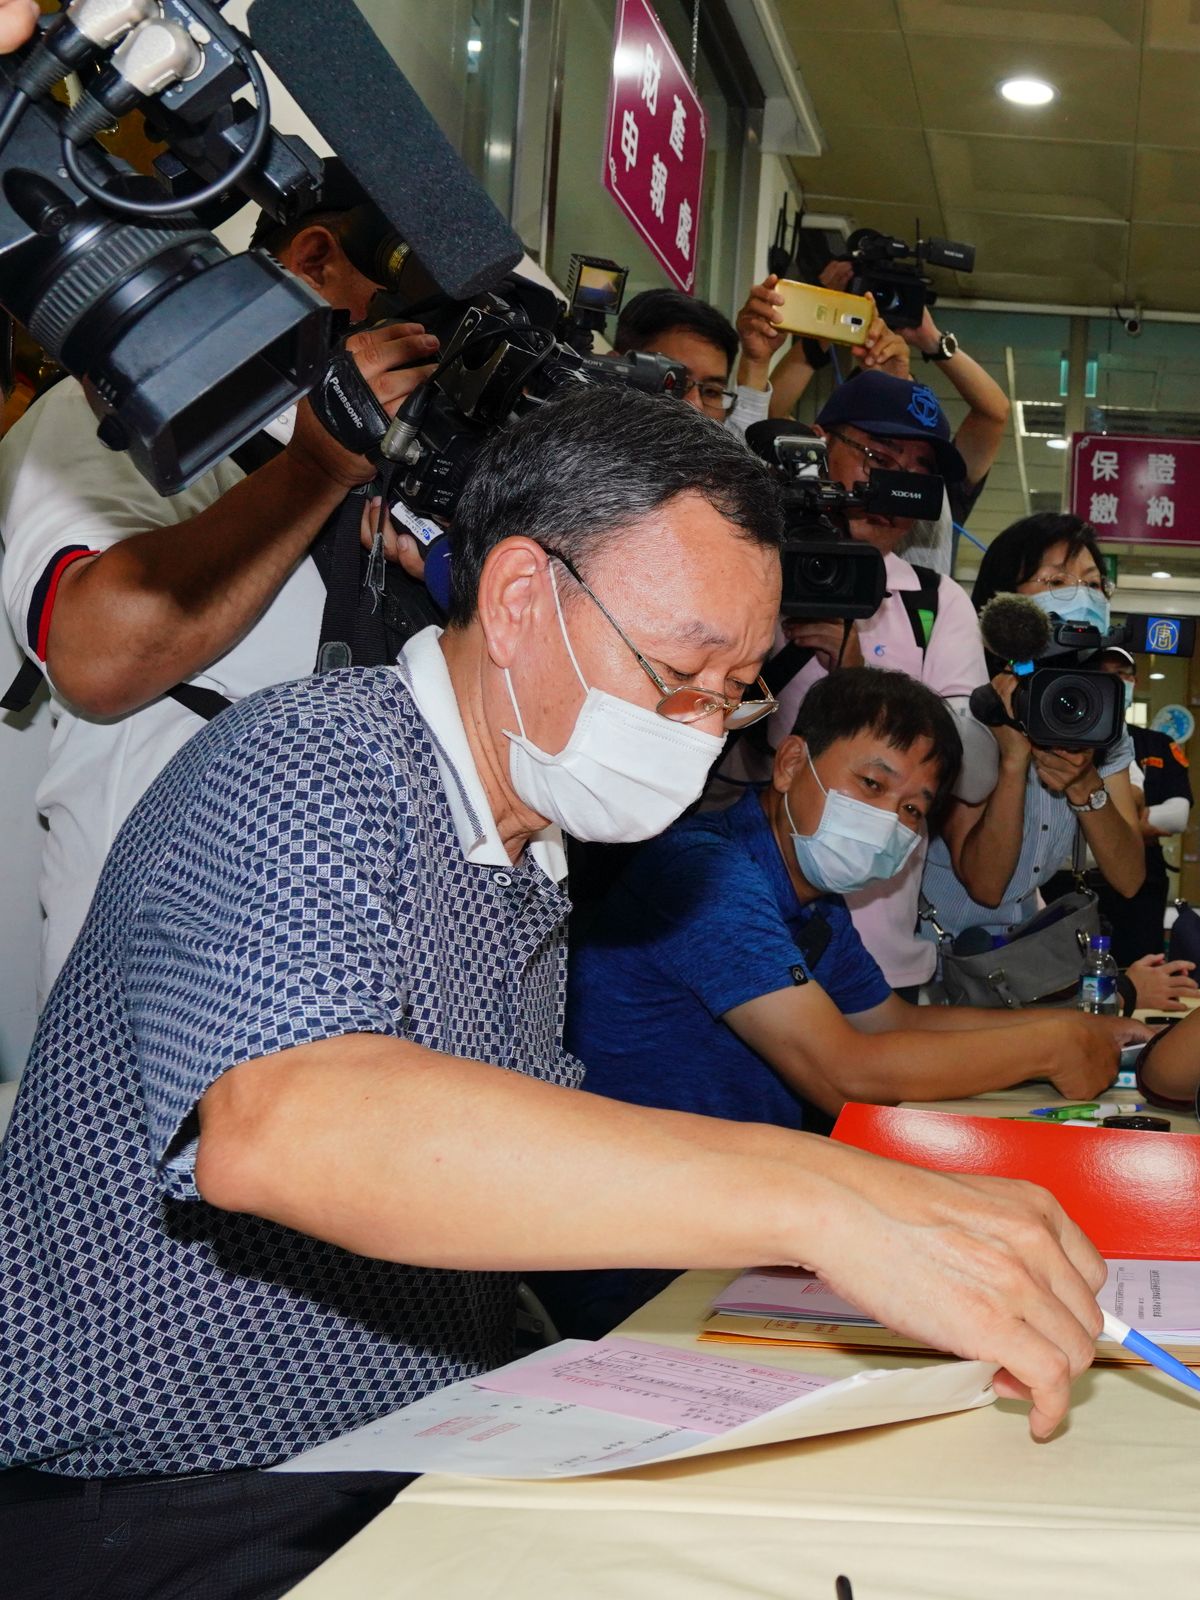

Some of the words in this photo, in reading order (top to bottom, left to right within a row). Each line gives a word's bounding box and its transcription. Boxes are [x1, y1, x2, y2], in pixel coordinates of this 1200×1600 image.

[641, 43, 687, 162] 財產
[621, 109, 693, 261] 申報處
[329, 376, 364, 429] Panasonic
[891, 489, 922, 499] XDCAM
